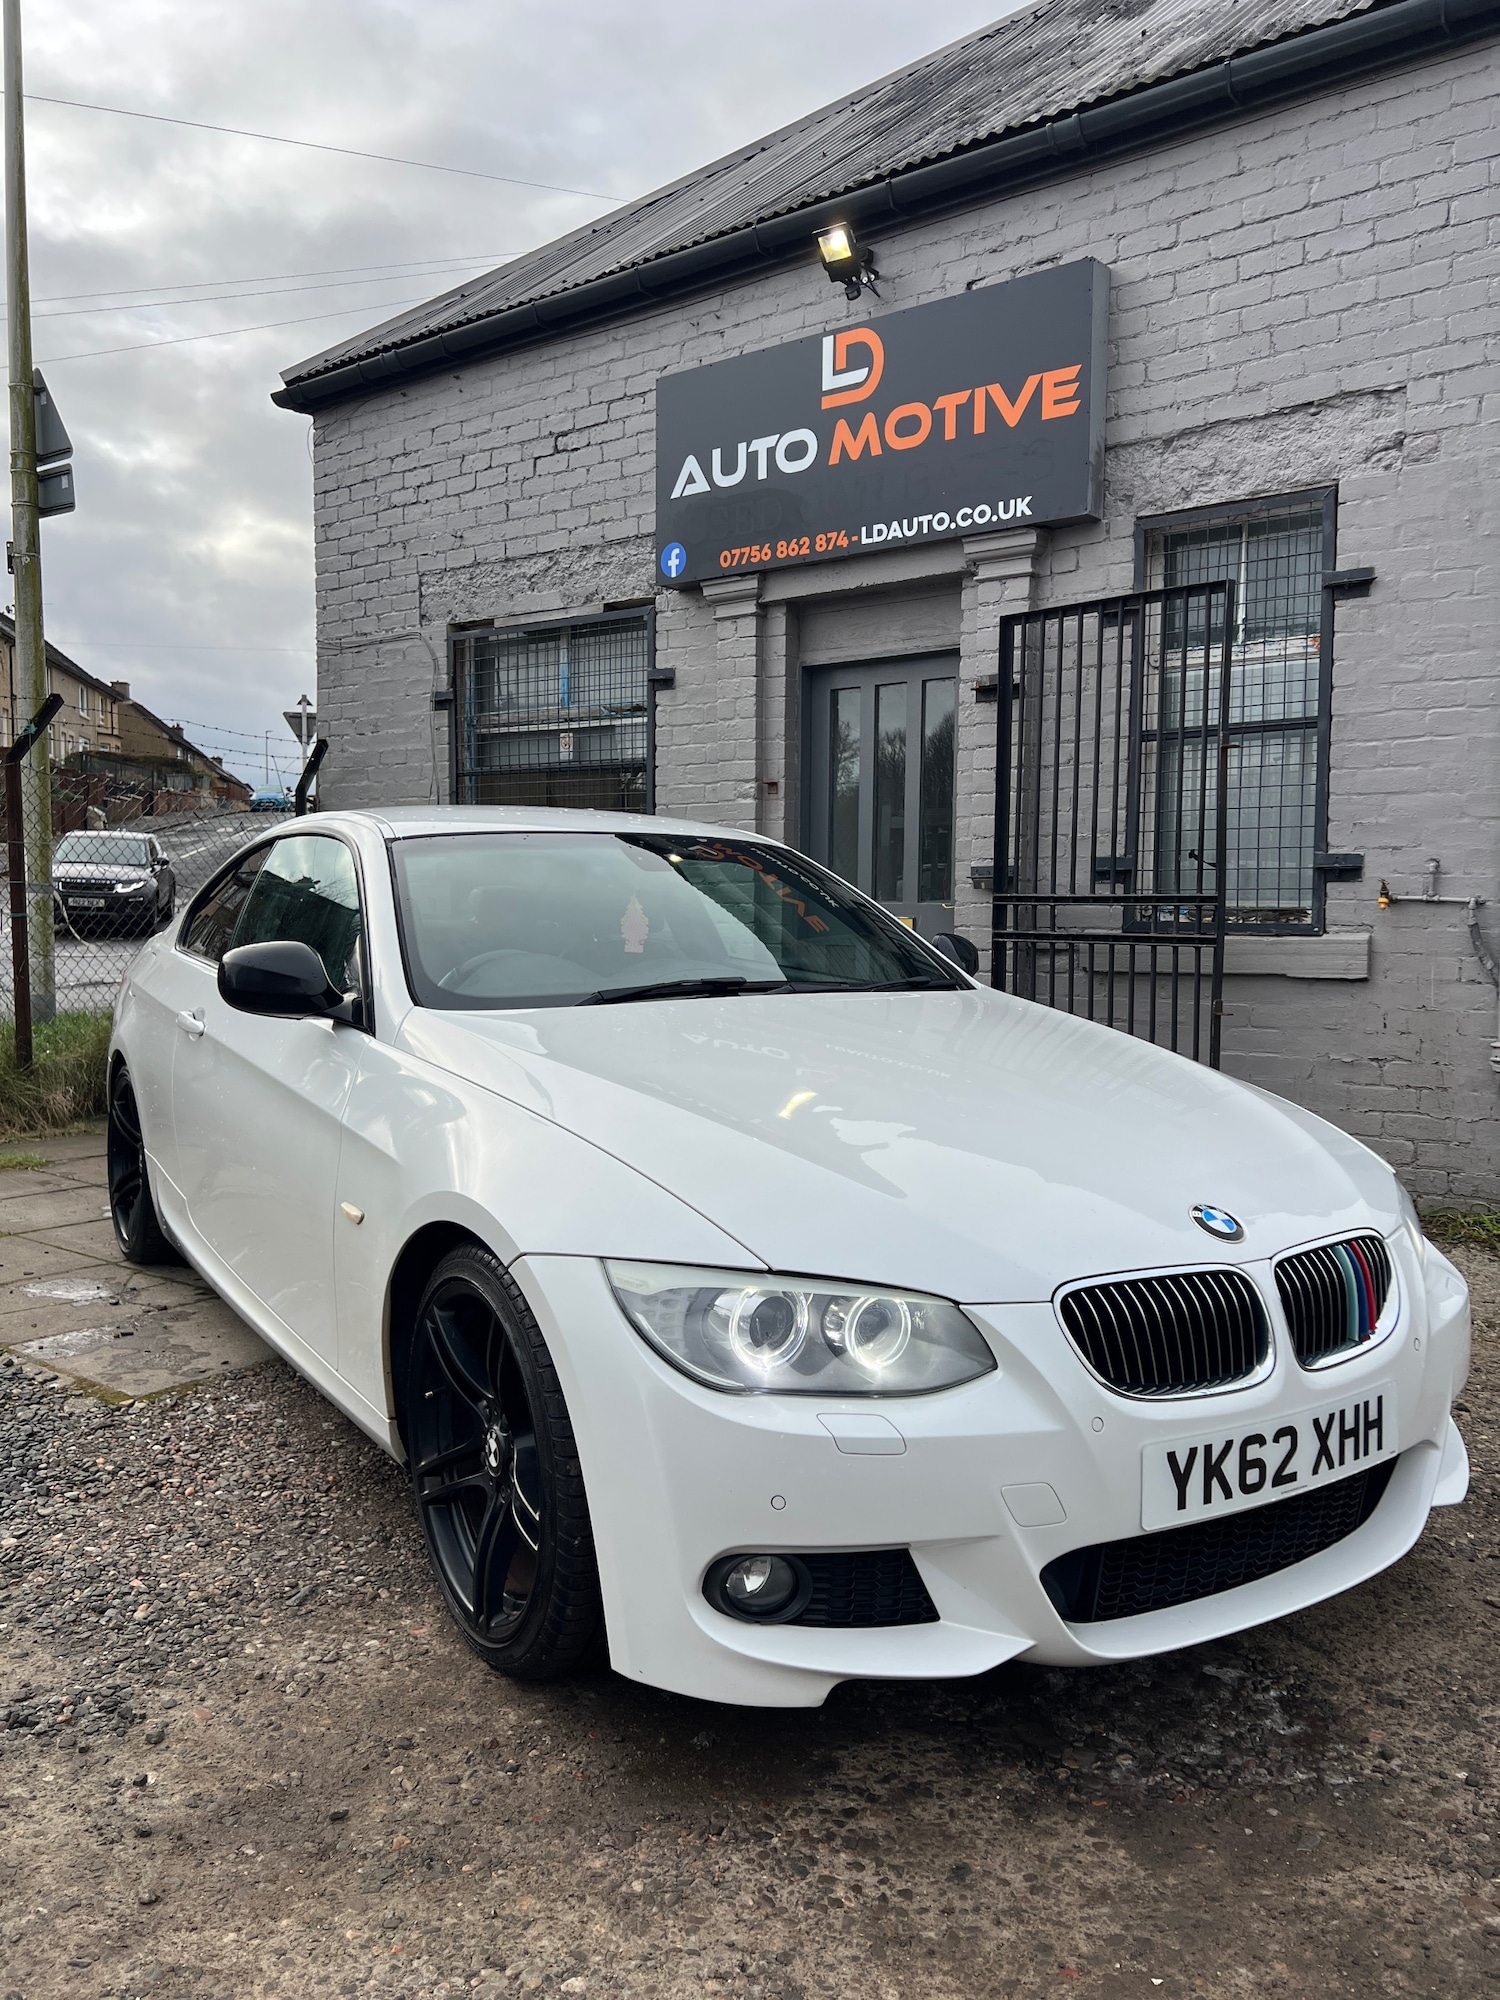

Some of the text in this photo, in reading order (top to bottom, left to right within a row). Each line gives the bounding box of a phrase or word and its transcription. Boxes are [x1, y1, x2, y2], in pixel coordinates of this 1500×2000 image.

[821, 327, 885, 410] LD
[670, 364, 1082, 499] AUTO MOTIVE
[719, 543, 772, 568] 07756
[776, 536, 810, 559] 862
[861, 496, 1033, 545] LDAUTO.CO.UK
[1166, 1395, 1383, 1512] YK62 XHH
